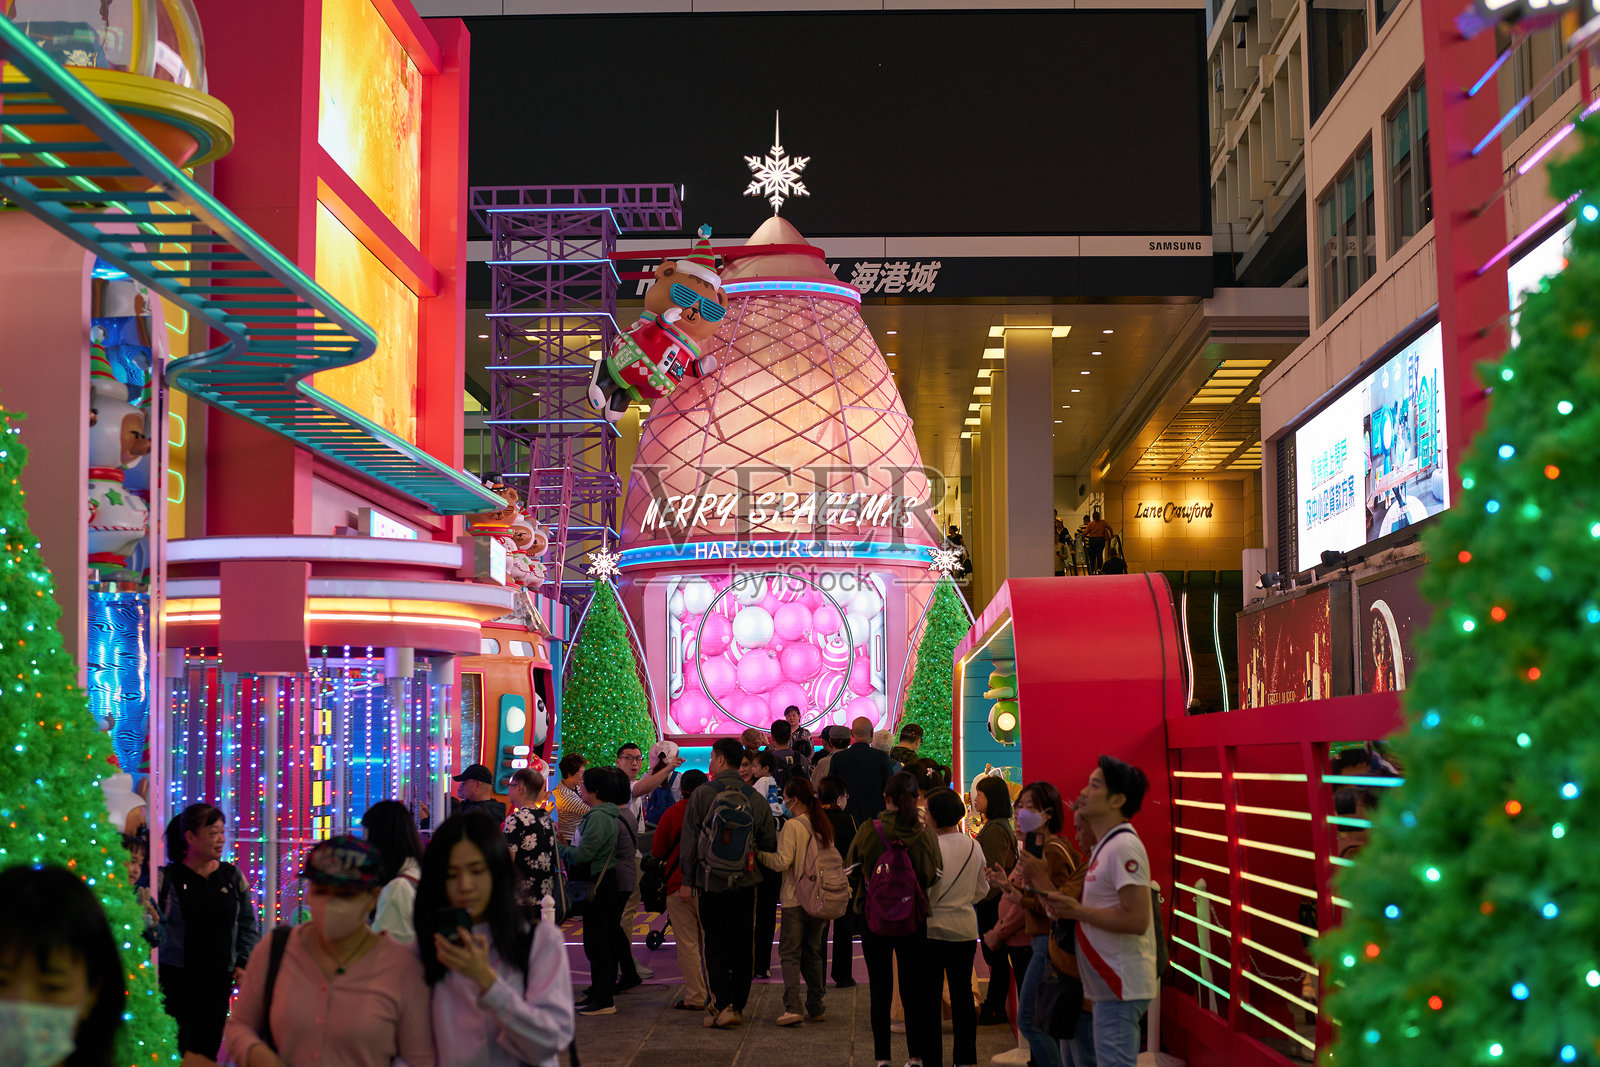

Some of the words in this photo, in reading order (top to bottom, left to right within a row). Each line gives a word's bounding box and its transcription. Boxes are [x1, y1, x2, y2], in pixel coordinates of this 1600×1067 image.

[1149, 241, 1202, 250] SAMSUNG
[850, 260, 941, 294] 海港城
[640, 492, 742, 533] MERRY
[750, 491, 919, 528] SPACEMAS
[1134, 503, 1162, 519] Lane
[1163, 502, 1214, 523] Crawford
[695, 541, 801, 560] HARBOUR
[806, 541, 854, 559] CITY
